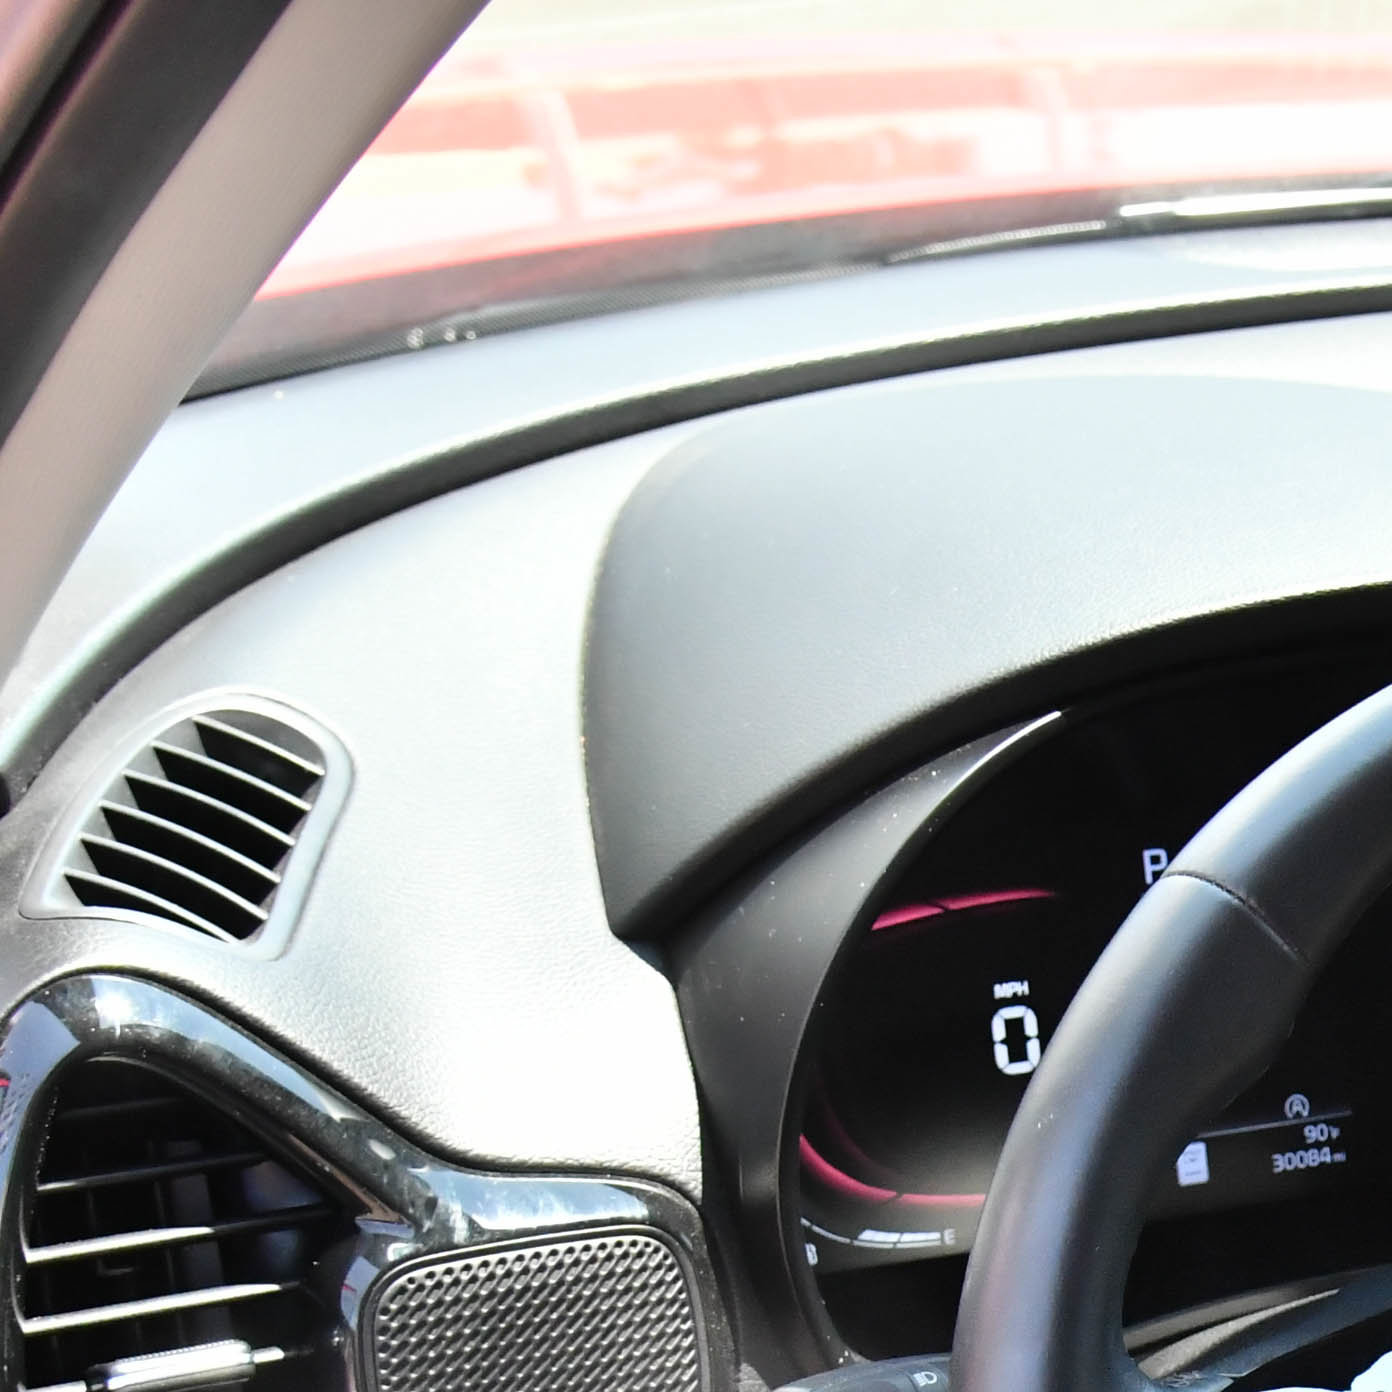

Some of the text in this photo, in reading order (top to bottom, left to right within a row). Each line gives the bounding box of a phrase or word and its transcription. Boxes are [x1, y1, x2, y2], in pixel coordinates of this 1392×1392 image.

[1142, 848, 1168, 885] P
[993, 980, 1030, 999] MPH
[991, 1005, 1041, 1076] 0
